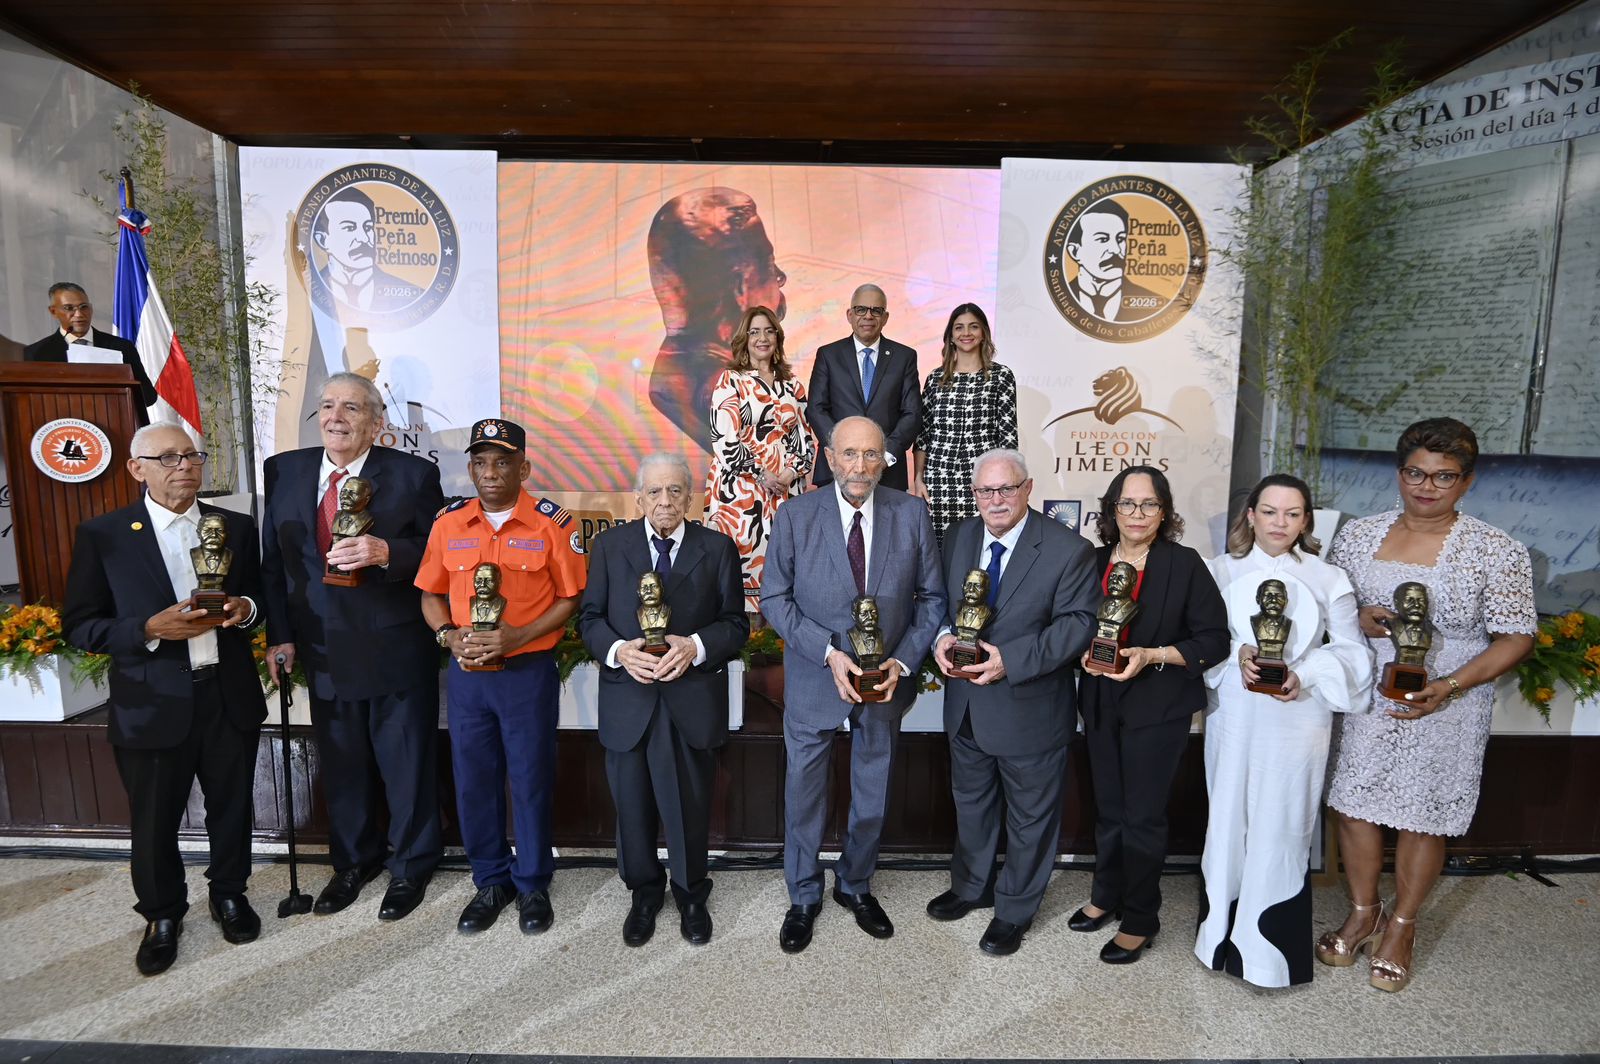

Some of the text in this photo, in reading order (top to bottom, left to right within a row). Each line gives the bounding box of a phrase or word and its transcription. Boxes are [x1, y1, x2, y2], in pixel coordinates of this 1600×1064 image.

[1463, 86, 1510, 118] DE
[1521, 64, 1600, 104] INST
[1411, 126, 1475, 151] Sesión
[1482, 115, 1513, 137] del
[1521, 109, 1555, 129] día
[1563, 101, 1578, 119] 4
[300, 185, 331, 235] ATENEO
[333, 168, 397, 188] AMANTES
[400, 176, 420, 193] DE
[421, 191, 435, 209] LA
[434, 210, 451, 237] LUZ
[375, 206, 429, 225] Premio
[1053, 180, 1200, 248] ATENEO AMANTES DE LA LUZ
[376, 227, 417, 245] Peña
[1129, 218, 1181, 236] Premio
[1128, 238, 1167, 256] Peña
[376, 247, 438, 266] Reinoso
[1126, 258, 1185, 277] Reinoso
[384, 287, 411, 297] 2026
[1050, 269, 1078, 318] Santiago
[1080, 317, 1094, 330] de
[1096, 324, 1114, 336] los
[1129, 297, 1157, 308] 2026
[1017, 376, 1074, 388] OPULAR
[476, 420, 509, 439] DEFENSA CIVIL
[1071, 431, 1157, 440] FUNDACION
[380, 433, 418, 448] ON
[1075, 441, 1151, 456] LEON
